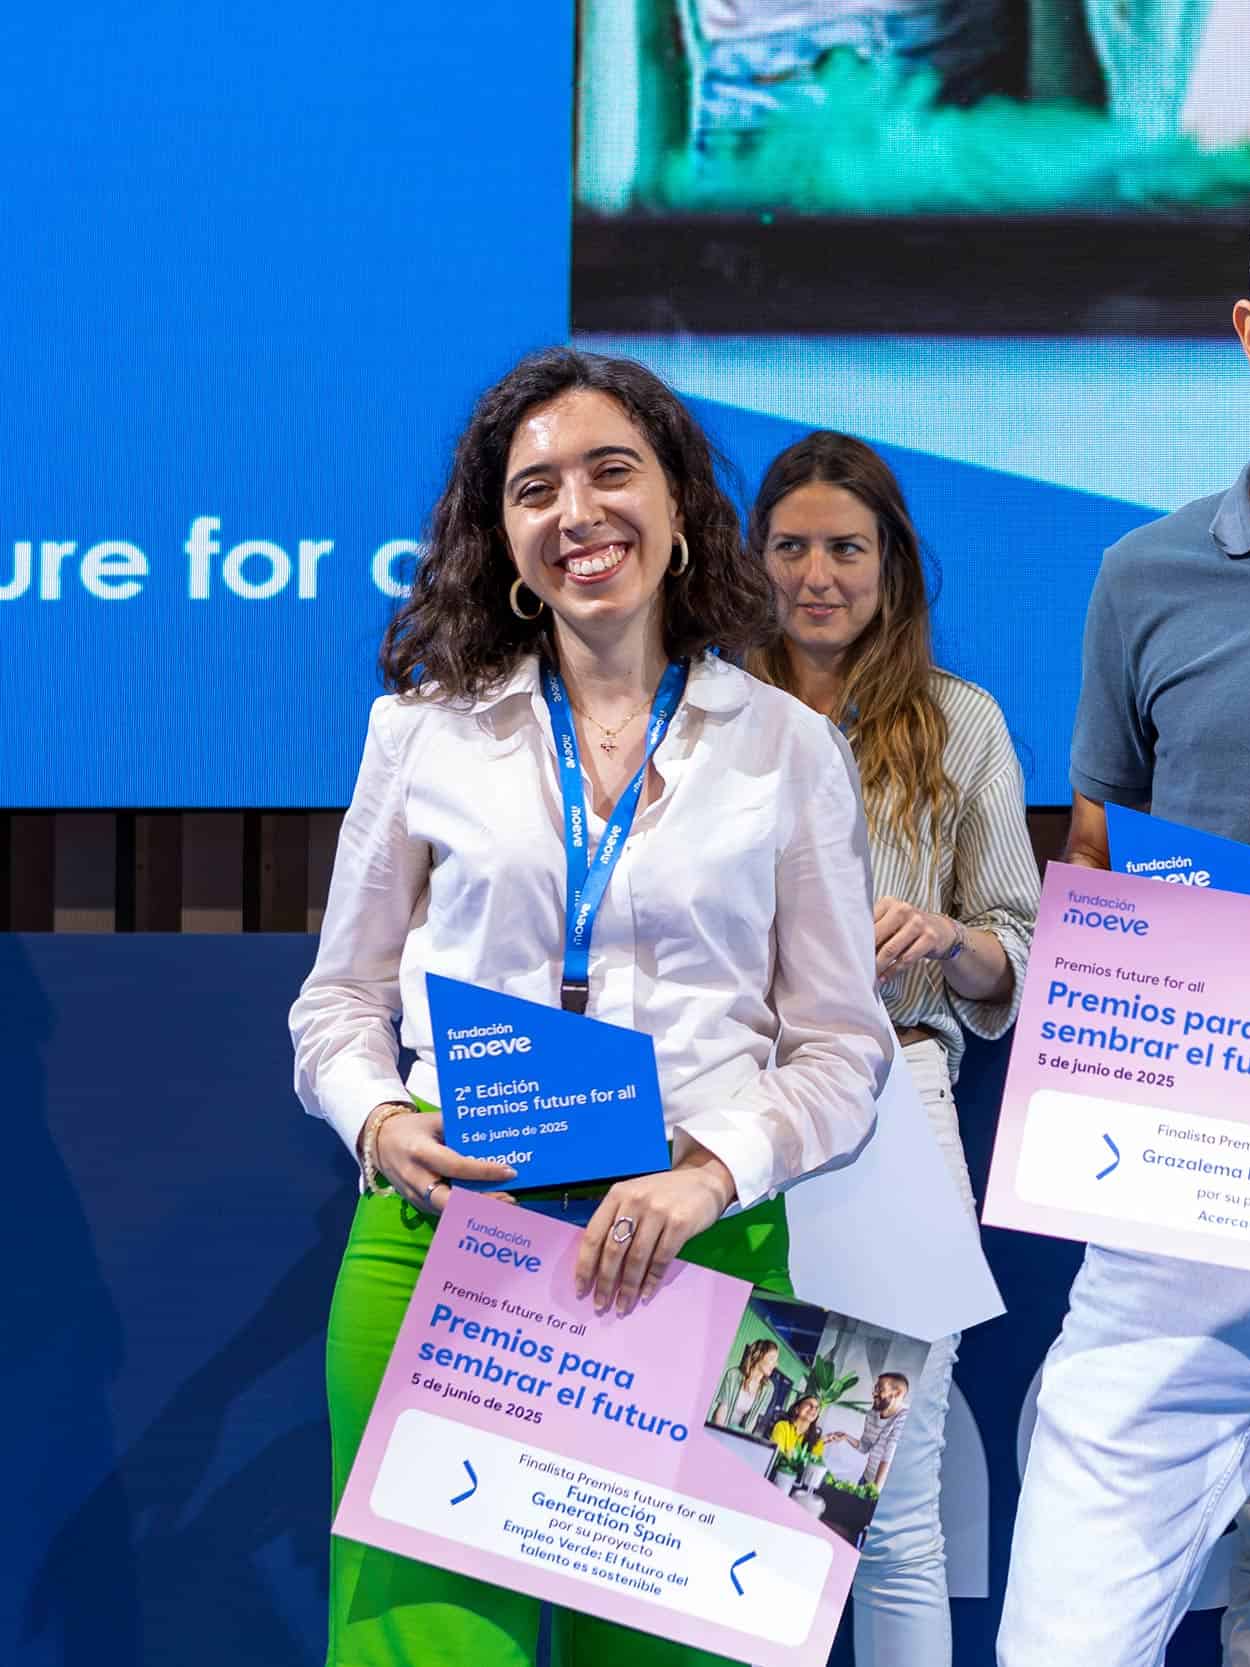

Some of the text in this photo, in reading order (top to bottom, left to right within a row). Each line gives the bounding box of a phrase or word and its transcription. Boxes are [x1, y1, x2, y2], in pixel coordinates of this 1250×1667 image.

[185, 517, 334, 600] for
[561, 734, 576, 769] moeve
[571, 806, 583, 848] moeve
[600, 824, 622, 865] moeve
[1126, 855, 1192, 873] fundación
[1068, 891, 1136, 912] fundación
[574, 903, 592, 946] moeve
[1063, 908, 1149, 936] moeve
[1055, 957, 1205, 993] Premios future for all
[1047, 980, 1176, 1025] Premios
[447, 1022, 513, 1041] fundación
[448, 1036, 532, 1061] moeve
[1041, 1020, 1179, 1061] sembrar
[1186, 1043, 1213, 1067] el
[1038, 1053, 1175, 1088] 5 de junio de 2025
[454, 1079, 539, 1101] 2ª Edición
[457, 1085, 636, 1120] Premios future for all
[461, 1121, 568, 1143] 5 de junio de 2025
[1157, 1124, 1216, 1145] Finalista
[1142, 1149, 1243, 1180] Grazalema
[1196, 1186, 1220, 1200] por
[1225, 1193, 1240, 1204] su
[466, 1218, 531, 1248] fundación
[458, 1236, 543, 1273] moeve
[443, 1281, 586, 1337] Premios future for all
[430, 1303, 635, 1389] Premios para
[411, 1373, 543, 1424] 5 de junio de 2025
[418, 1341, 689, 1441] sembrar el futuro
[518, 1453, 715, 1525] Finalista Premios future for all
[566, 1485, 657, 1525] Fundación
[531, 1491, 682, 1550] Generation Spain
[548, 1517, 653, 1558] por su proyecto
[503, 1519, 688, 1587] Empleo Verde: El futuro del
[520, 1543, 662, 1596] talento es sostenible
